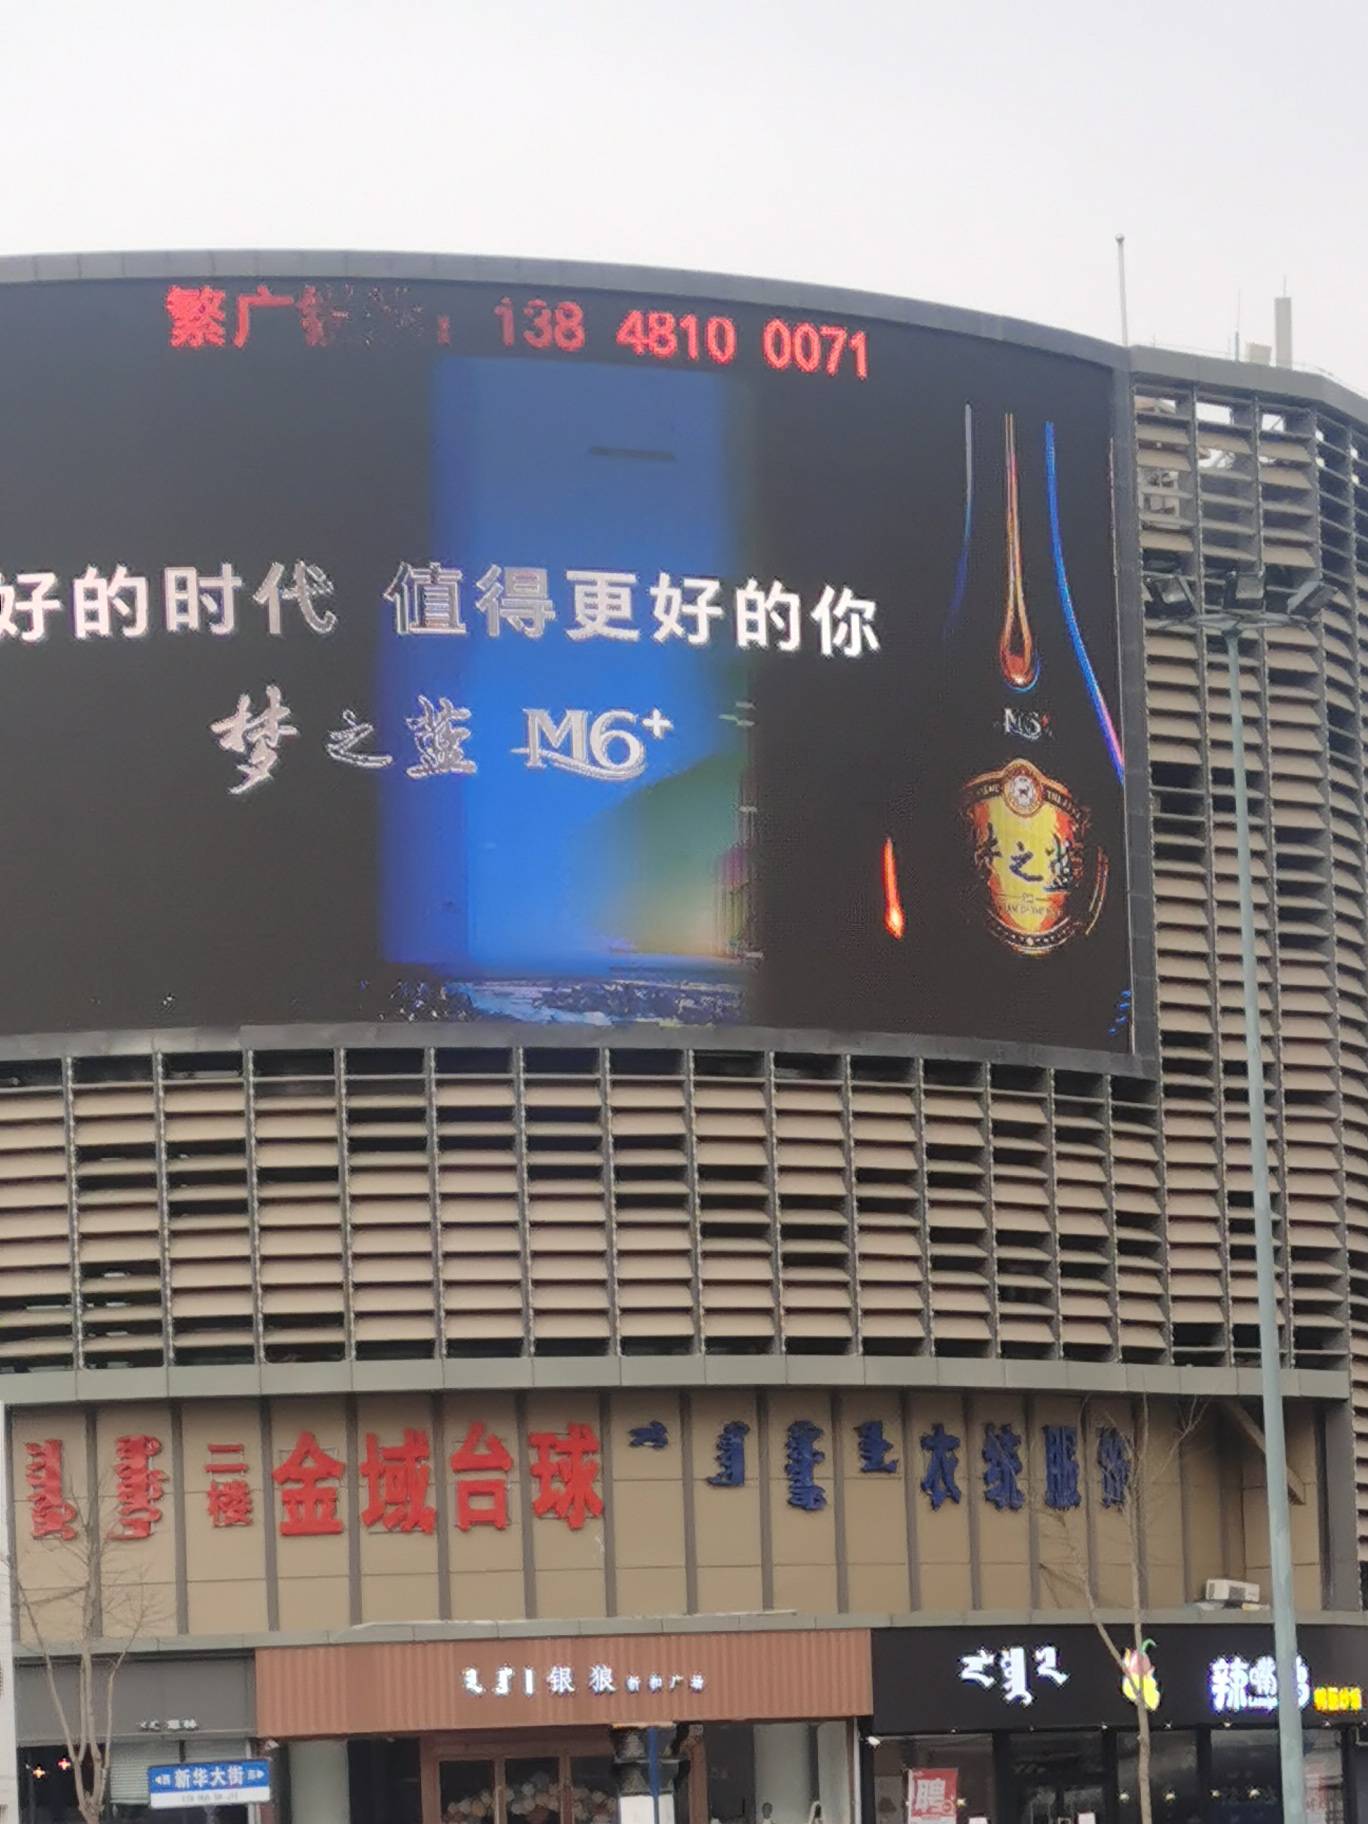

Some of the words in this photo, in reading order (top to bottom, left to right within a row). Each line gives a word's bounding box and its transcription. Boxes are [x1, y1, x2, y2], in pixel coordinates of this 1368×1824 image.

[495, 296, 586, 352] 138
[615, 309, 737, 366] 4810
[762, 317, 869, 381] 0071
[0, 561, 338, 643] 好的时代
[383, 561, 880, 659] 值得更好的你
[210, 684, 478, 794] 梦之蓝
[204, 1443, 254, 1529] 二楼
[272, 1421, 604, 1537] 金域台球
[548, 1664, 616, 1696] 银狼
[174, 1765, 245, 1789] 新华大街
